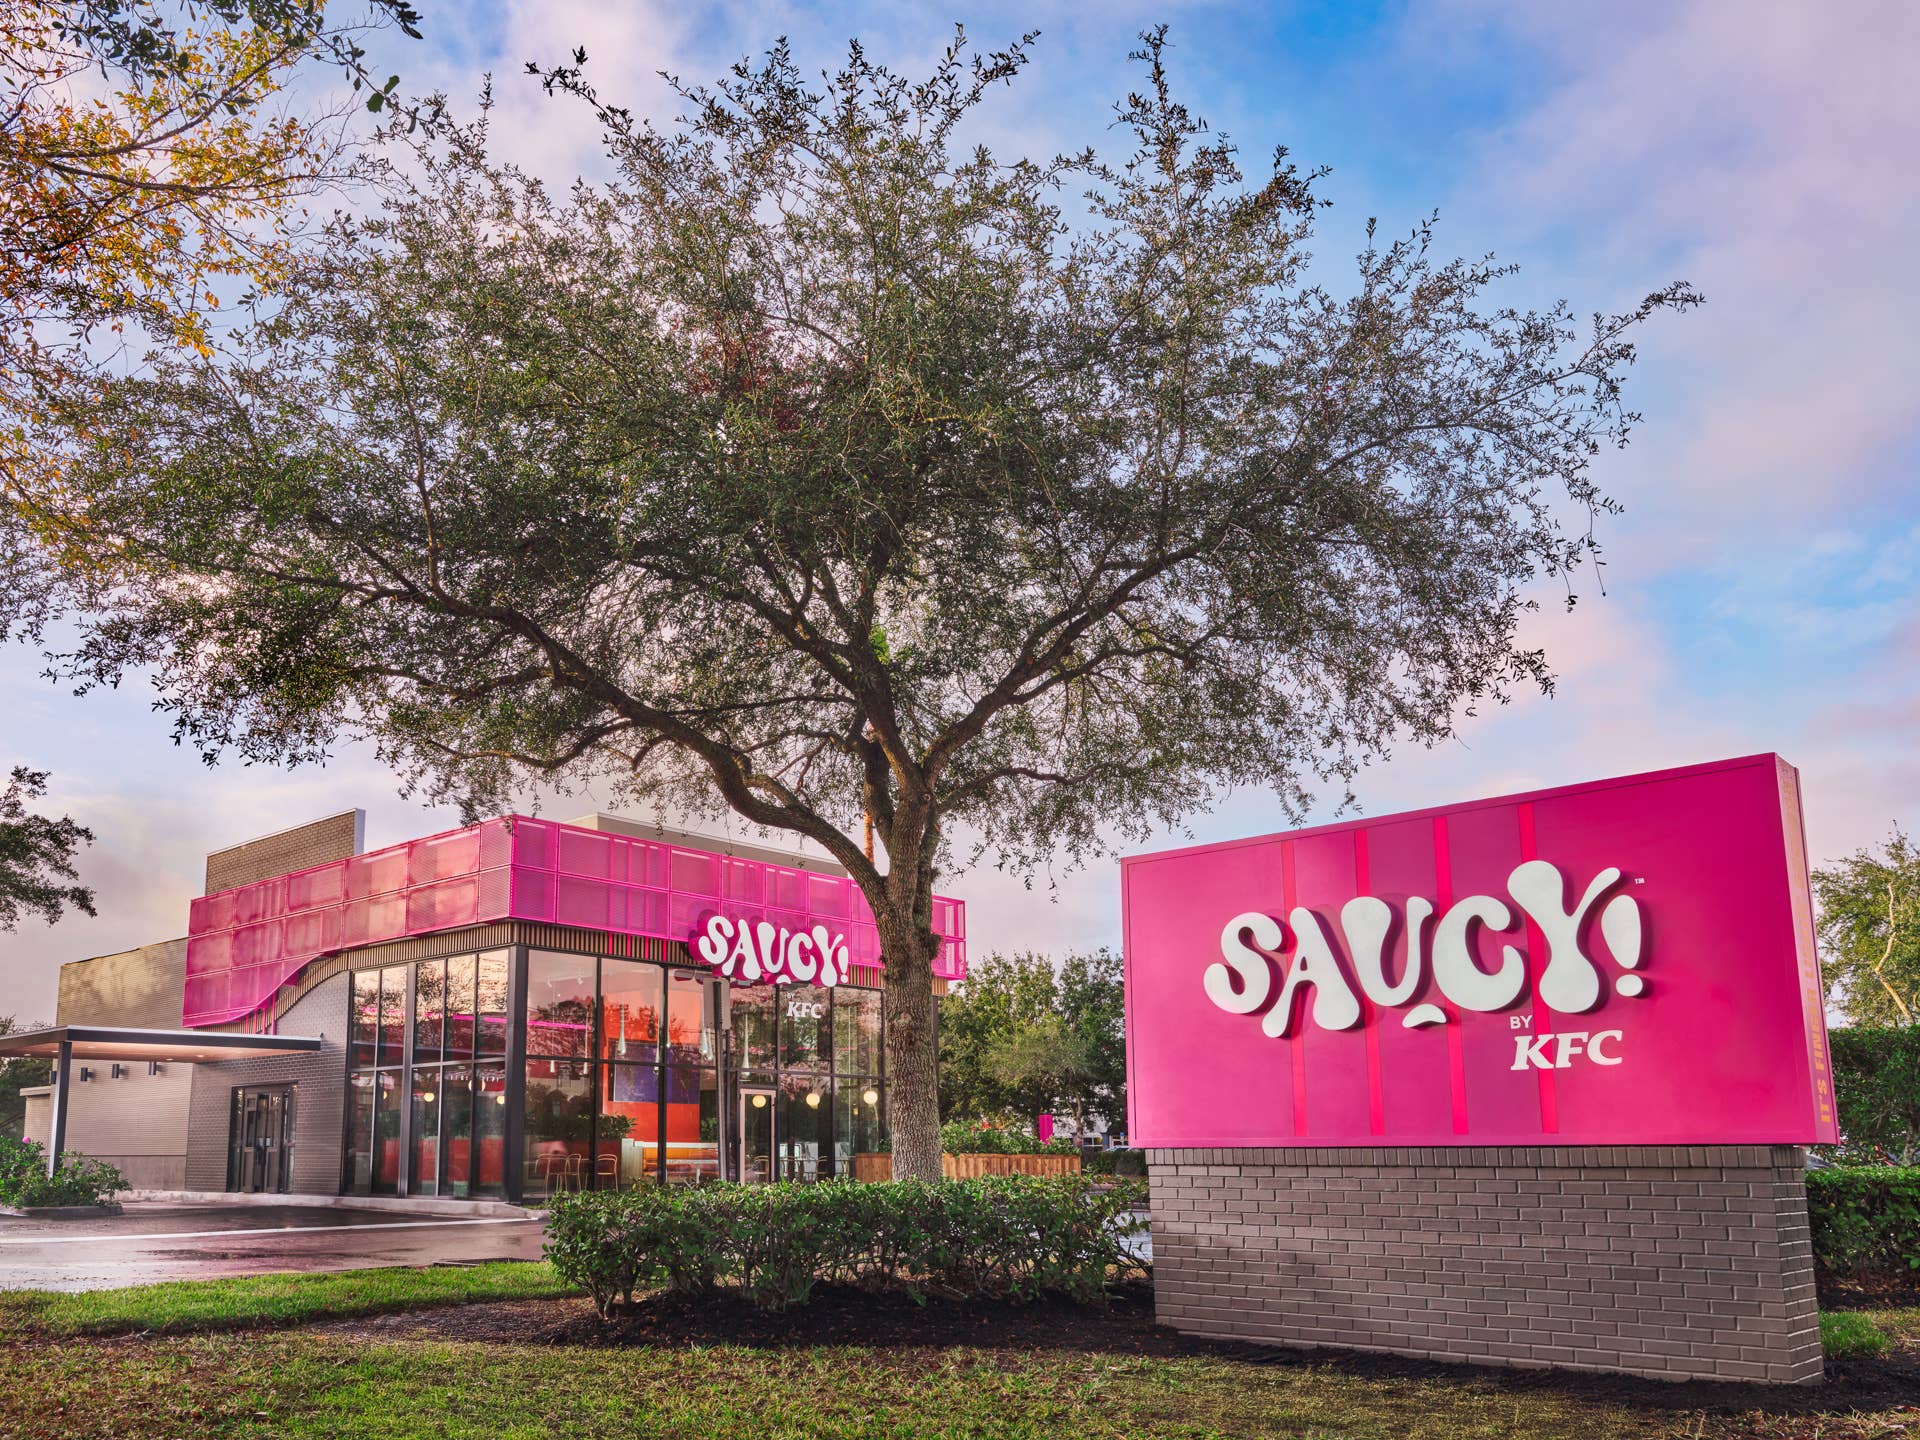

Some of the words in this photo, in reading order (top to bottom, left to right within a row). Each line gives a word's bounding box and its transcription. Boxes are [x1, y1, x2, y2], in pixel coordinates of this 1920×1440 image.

[698, 915, 849, 987] SAUCY!
[1203, 859, 1644, 1038] SAUCY!
[786, 1001, 822, 1019] KFC
[1509, 1014, 1533, 1029] BY
[1510, 1029, 1623, 1071] KFC
[1816, 1079, 1831, 1123] IT'S
